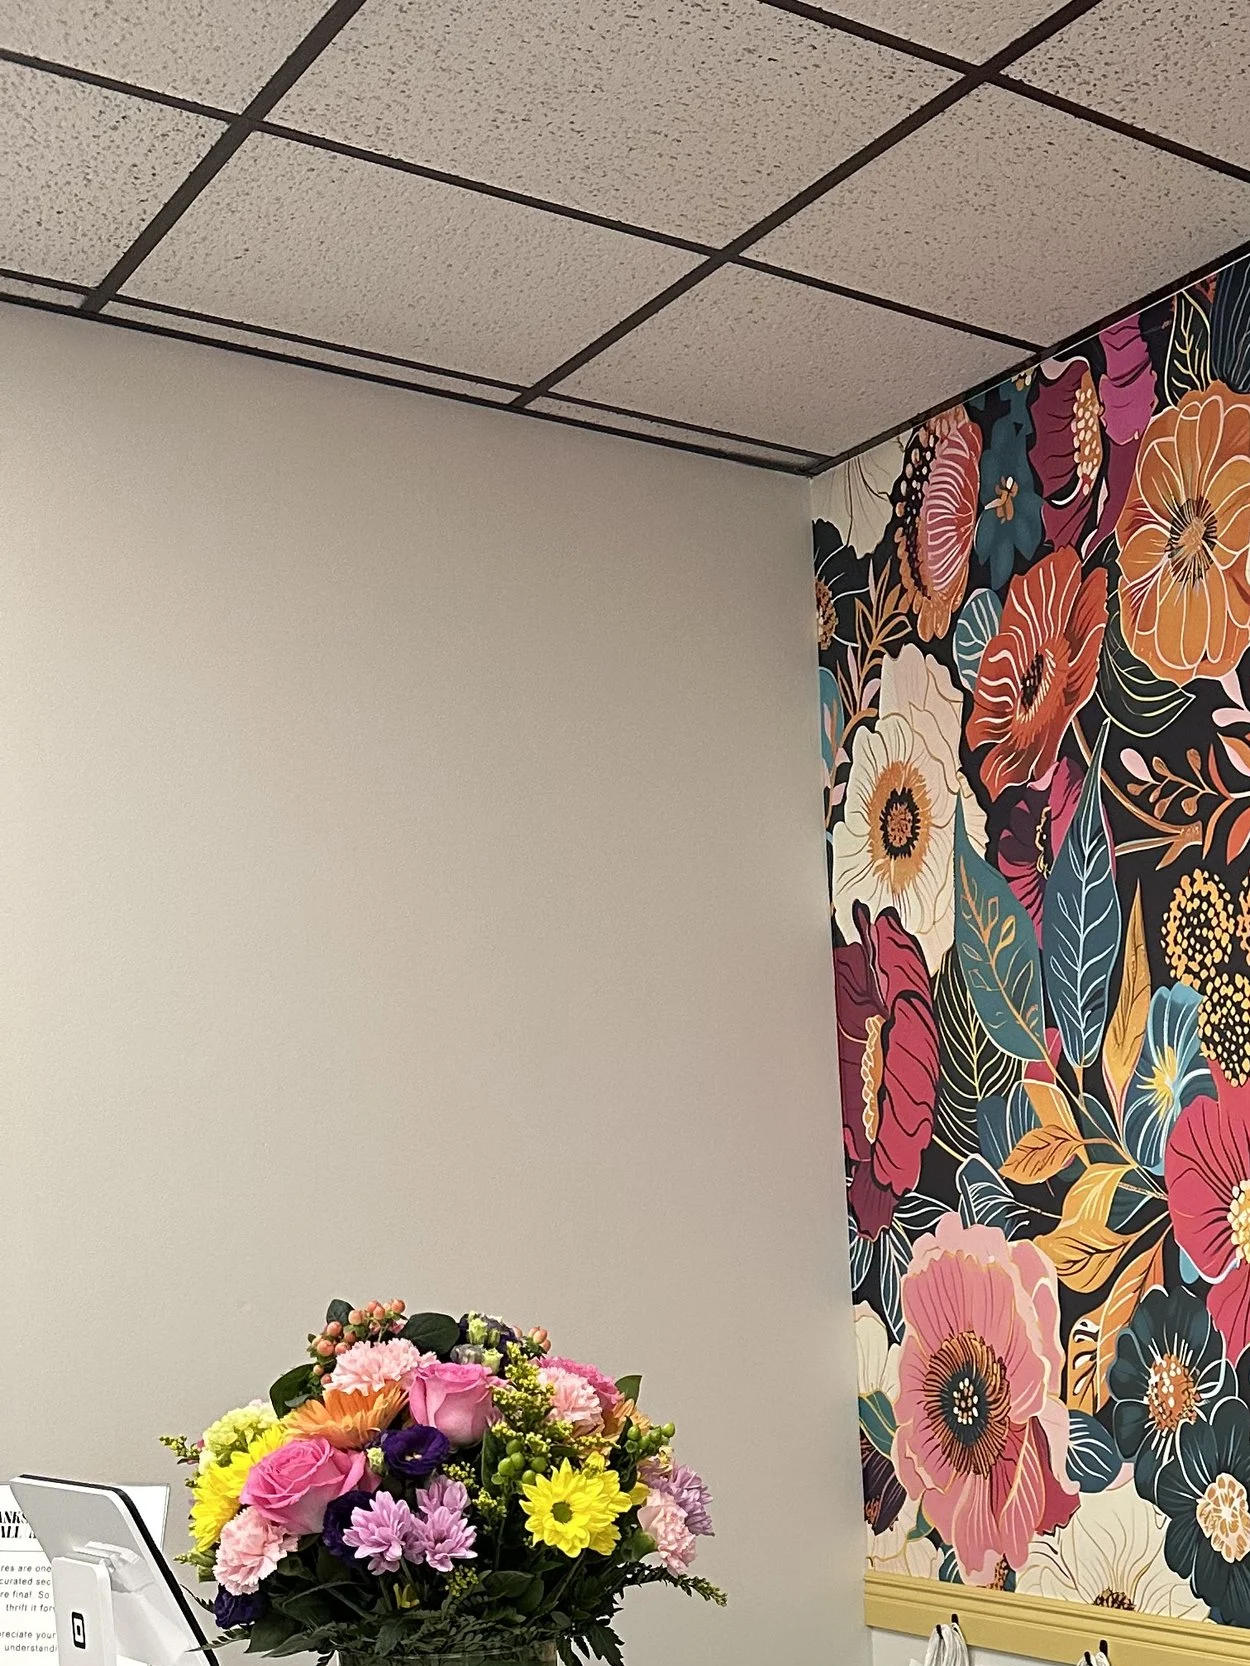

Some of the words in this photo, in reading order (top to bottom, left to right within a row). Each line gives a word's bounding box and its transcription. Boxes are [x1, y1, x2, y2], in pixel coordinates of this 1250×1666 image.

[18, 1565, 32, 1573] are
[38, 1590, 50, 1599] So
[6, 1603, 27, 1612] thrift
[0, 1630, 33, 1639] reciate
[36, 1632, 56, 1641] your
